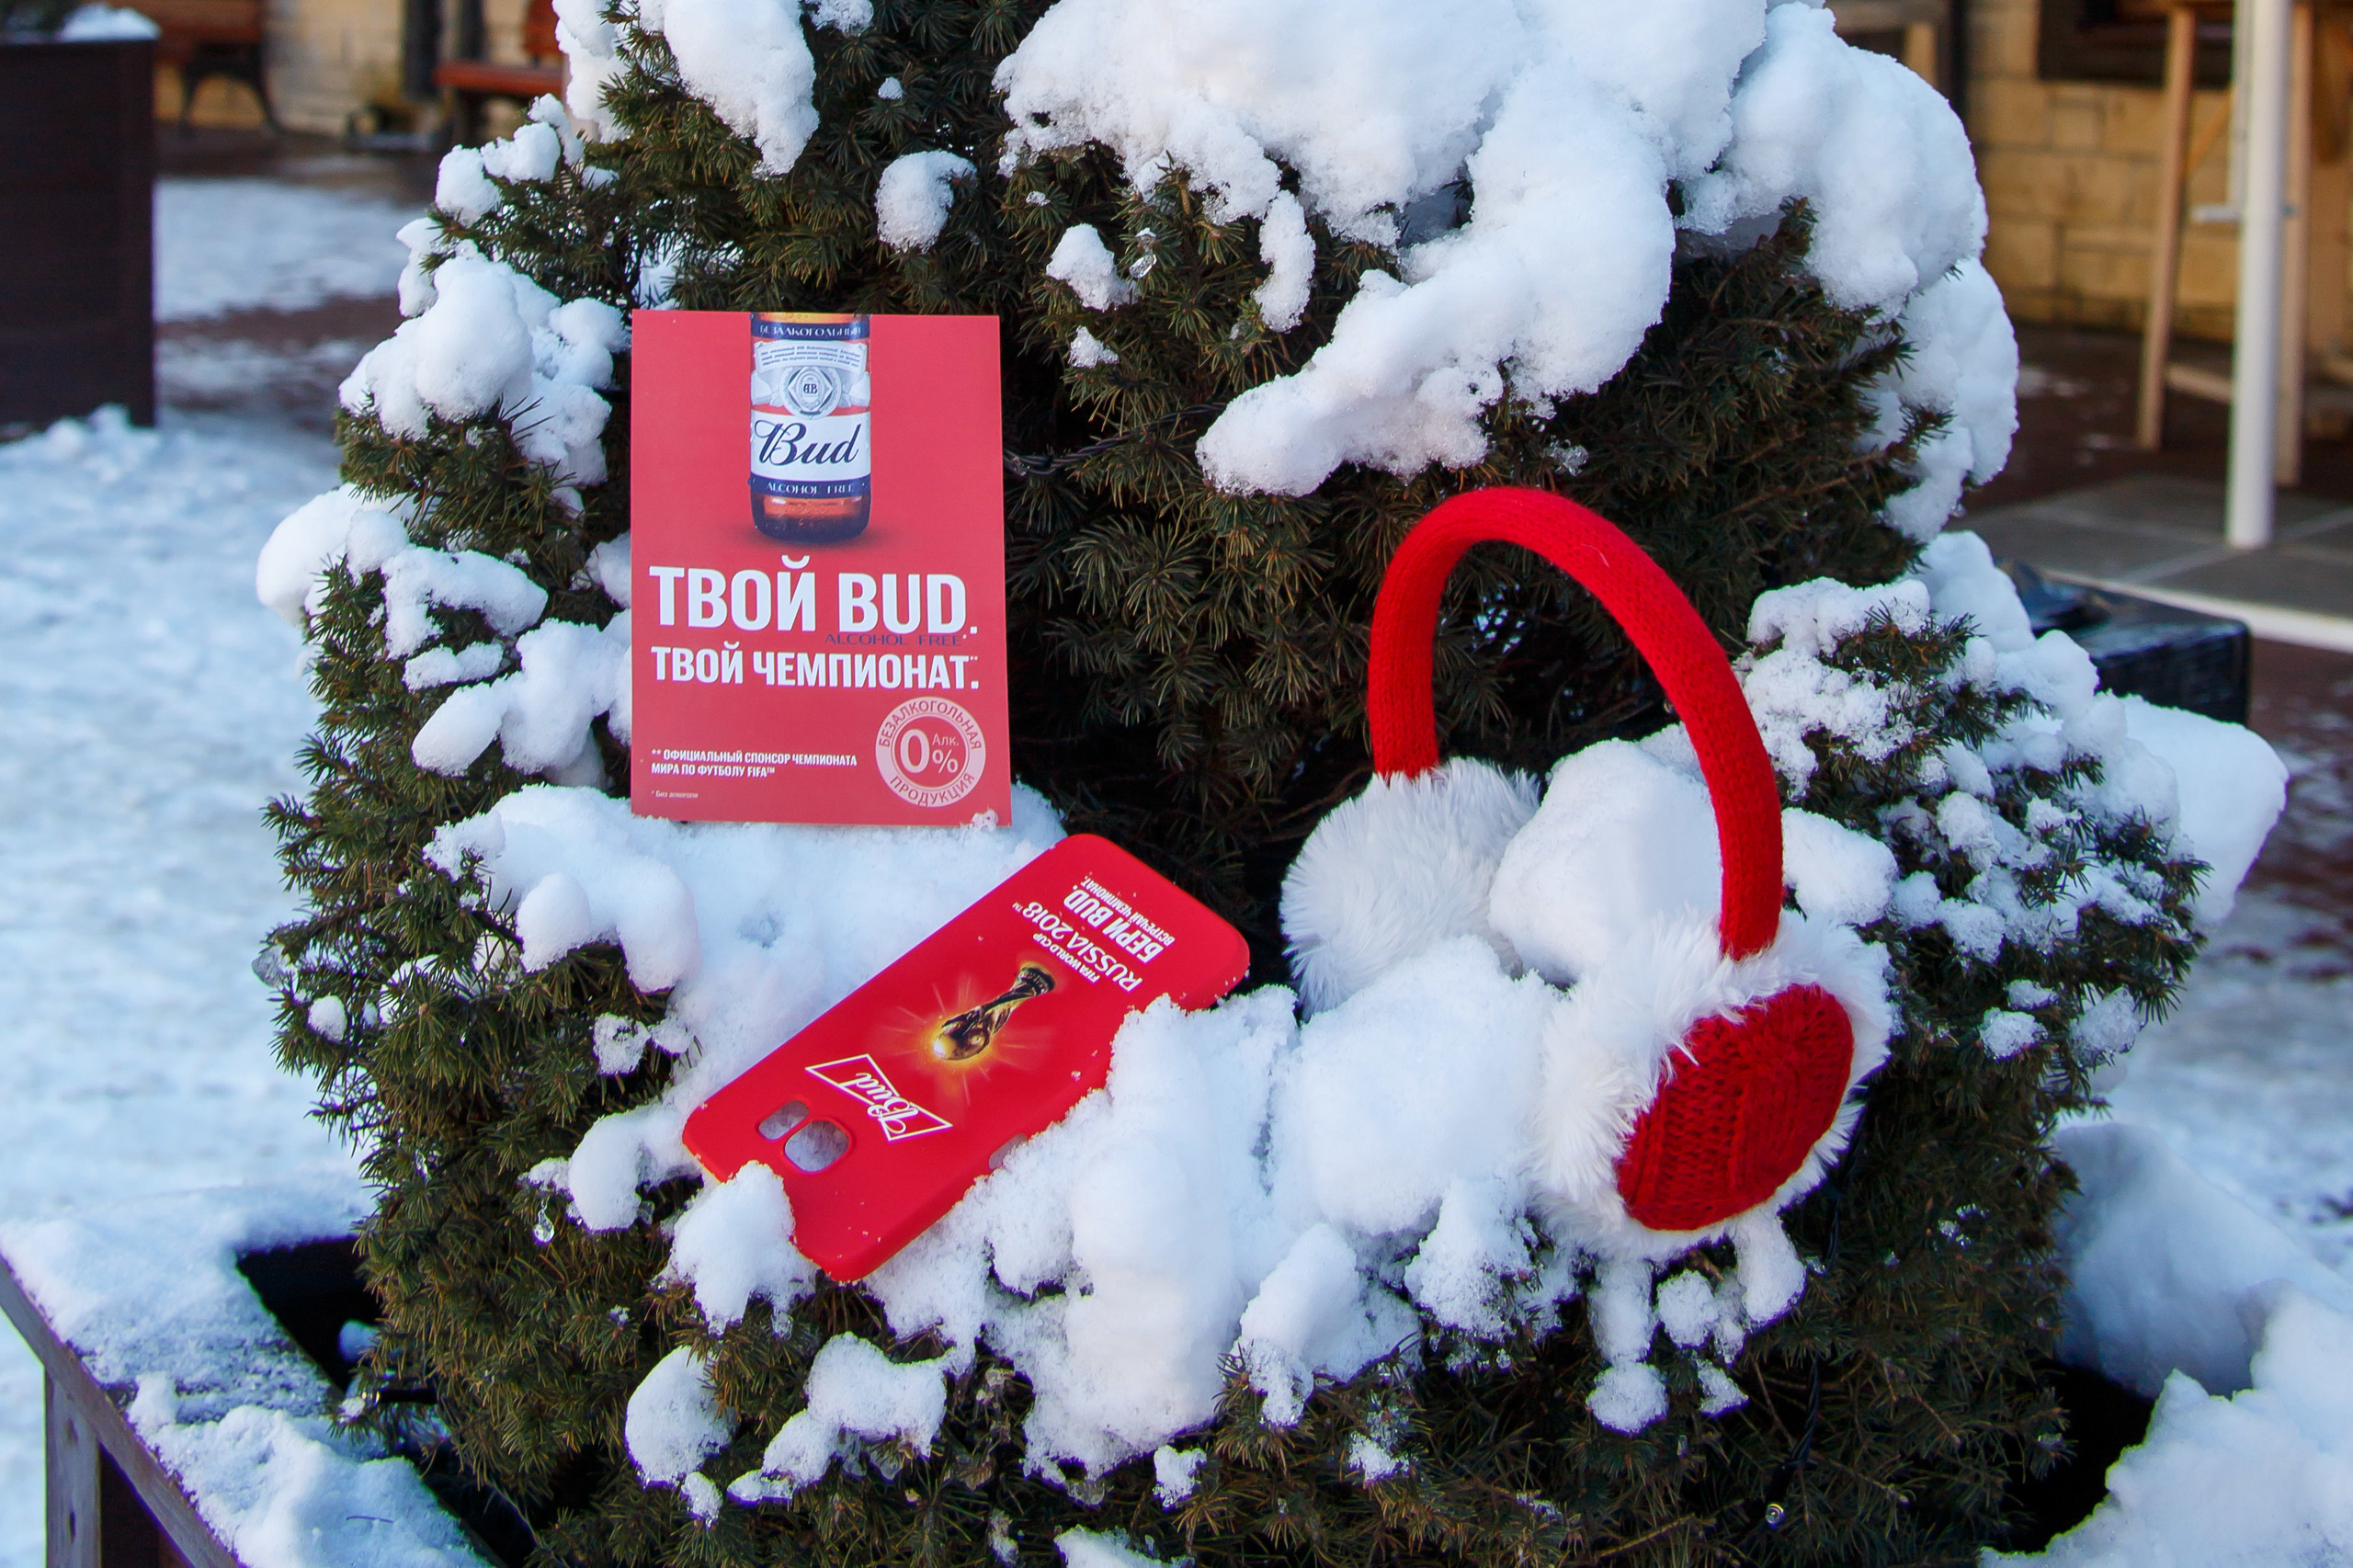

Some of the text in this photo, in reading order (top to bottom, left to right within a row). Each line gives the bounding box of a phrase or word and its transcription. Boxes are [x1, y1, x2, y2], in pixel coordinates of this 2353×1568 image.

[754, 419, 862, 466] Bud
[767, 482, 821, 495] ALCOHOL
[649, 554, 978, 635] ТВОЙ BUD.
[824, 633, 909, 646] ALCOHOL
[651, 641, 744, 684] ТВОЙ
[879, 699, 982, 750] БЕЗАЛКОГОЛЬНАЯ
[651, 763, 679, 775] МИРА
[681, 764, 696, 776] ПО
[697, 764, 745, 778] ФУТБОЛУ
[663, 749, 858, 767] ОФИЦИАЛЬНЫЙ СПОНСОР ЧЕМПИОНАТА
[890, 773, 974, 807] ПРОДУКЦИЯ
[1102, 916, 1164, 962] БЕРИ
[1127, 912, 1175, 946] ВСТРЕЧАЙ
[1033, 933, 1100, 983] FIFA WORLD CUP
[1067, 931, 1142, 991] RUSSIA
[838, 1072, 919, 1134] Bud
